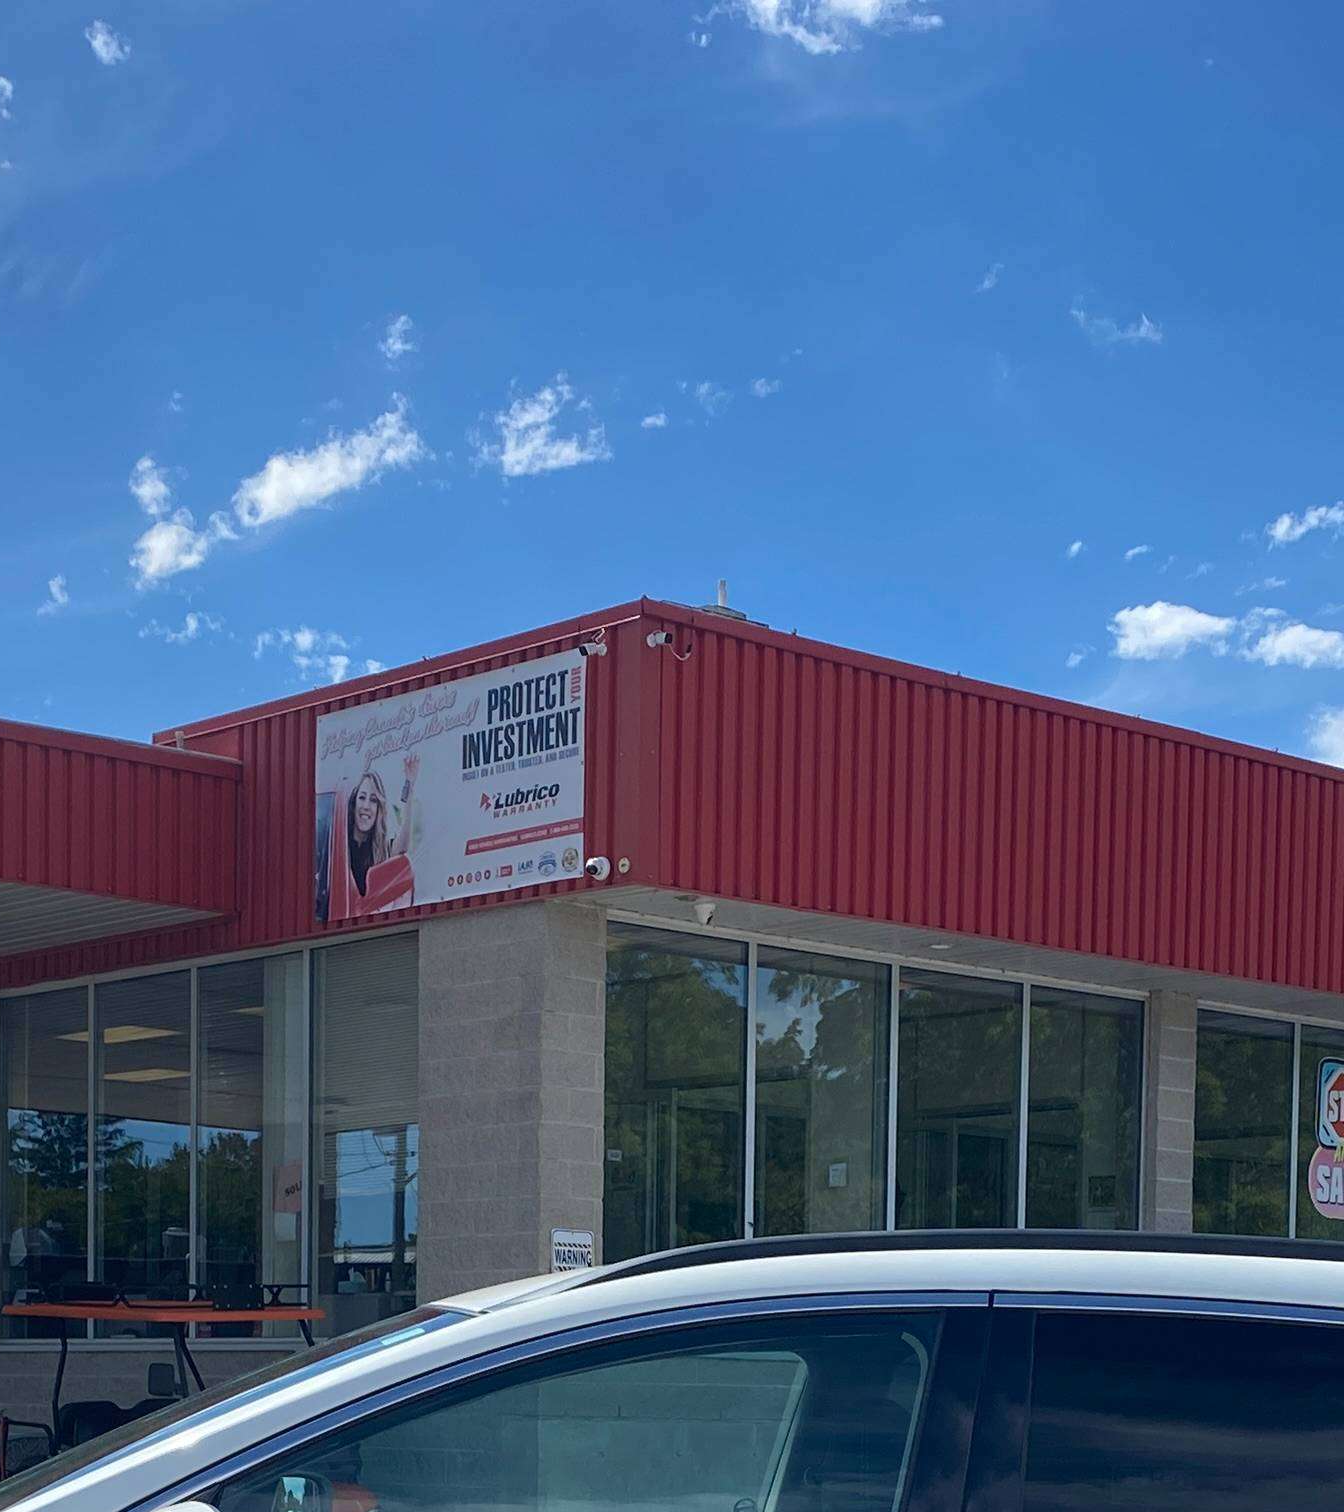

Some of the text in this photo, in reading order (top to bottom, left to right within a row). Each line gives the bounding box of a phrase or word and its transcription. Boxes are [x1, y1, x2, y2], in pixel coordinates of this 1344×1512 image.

[487, 666, 582, 725] PROTECT YOUR
[462, 707, 580, 770] INVESTMENT
[493, 799, 558, 818] WARRANTY
[494, 784, 560, 809] Lubrico
[554, 1248, 592, 1267] WARNING
